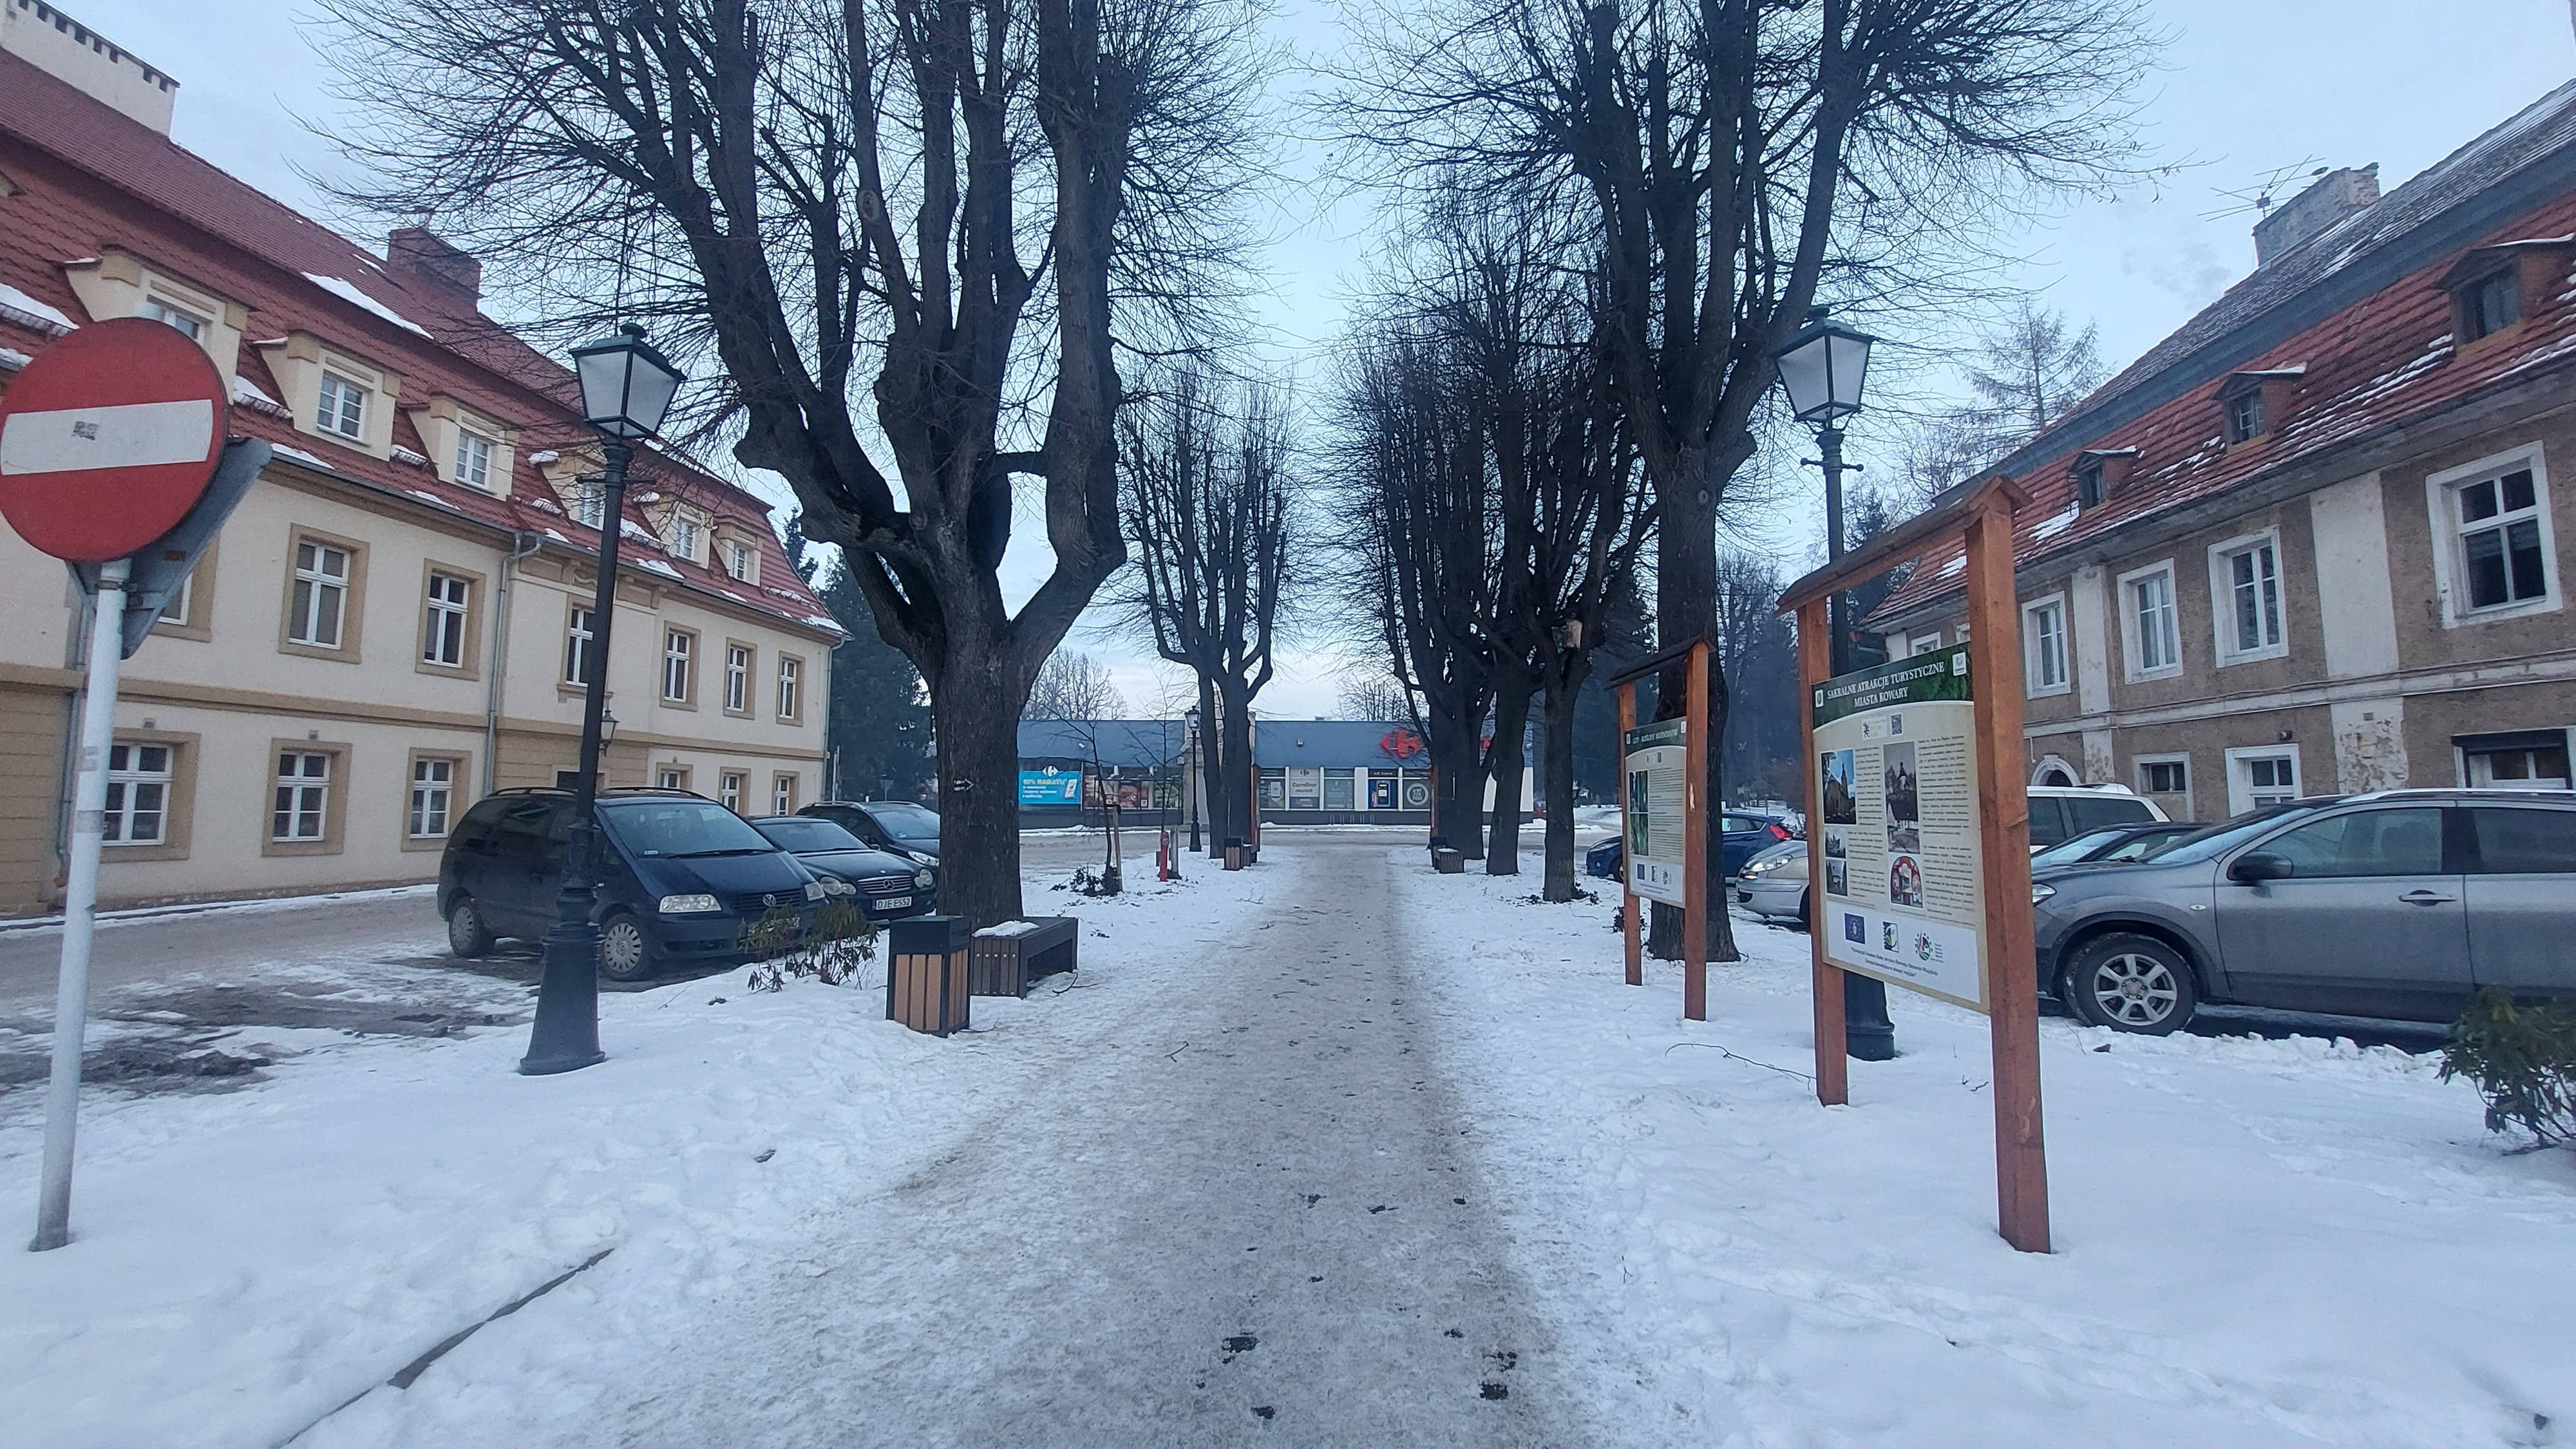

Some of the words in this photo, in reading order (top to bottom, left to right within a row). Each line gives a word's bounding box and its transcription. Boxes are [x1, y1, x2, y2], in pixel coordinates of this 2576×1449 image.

[1827, 684, 1857, 699] SAKRALNE
[1857, 676, 1889, 694] ATRAKCJE
[1890, 661, 1945, 685] TURYSTYCZNE
[1854, 694, 1878, 708] MIASTA
[1879, 687, 1909, 703] KOWARY
[878, 900, 892, 909] DJE
